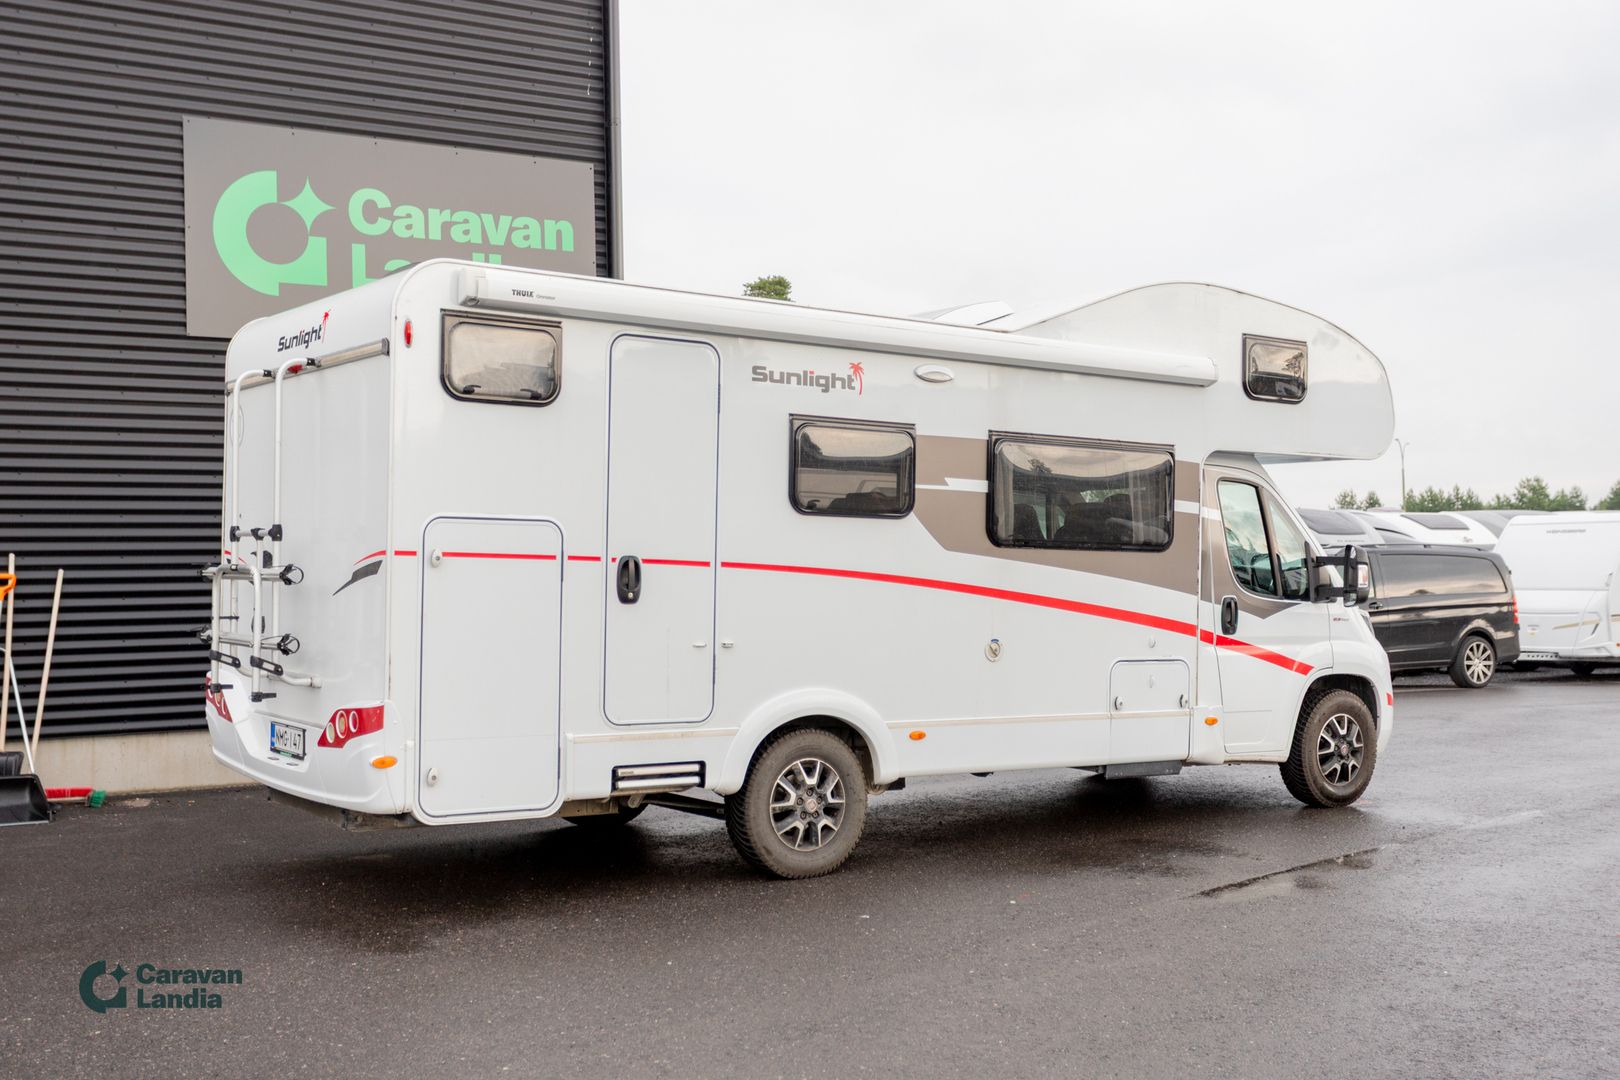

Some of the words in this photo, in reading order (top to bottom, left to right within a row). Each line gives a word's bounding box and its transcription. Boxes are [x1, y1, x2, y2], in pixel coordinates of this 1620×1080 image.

[348, 188, 574, 252] Caravan
[512, 289, 534, 298] THULE
[277, 324, 322, 352] Sunlight
[751, 365, 856, 393] Sunlight
